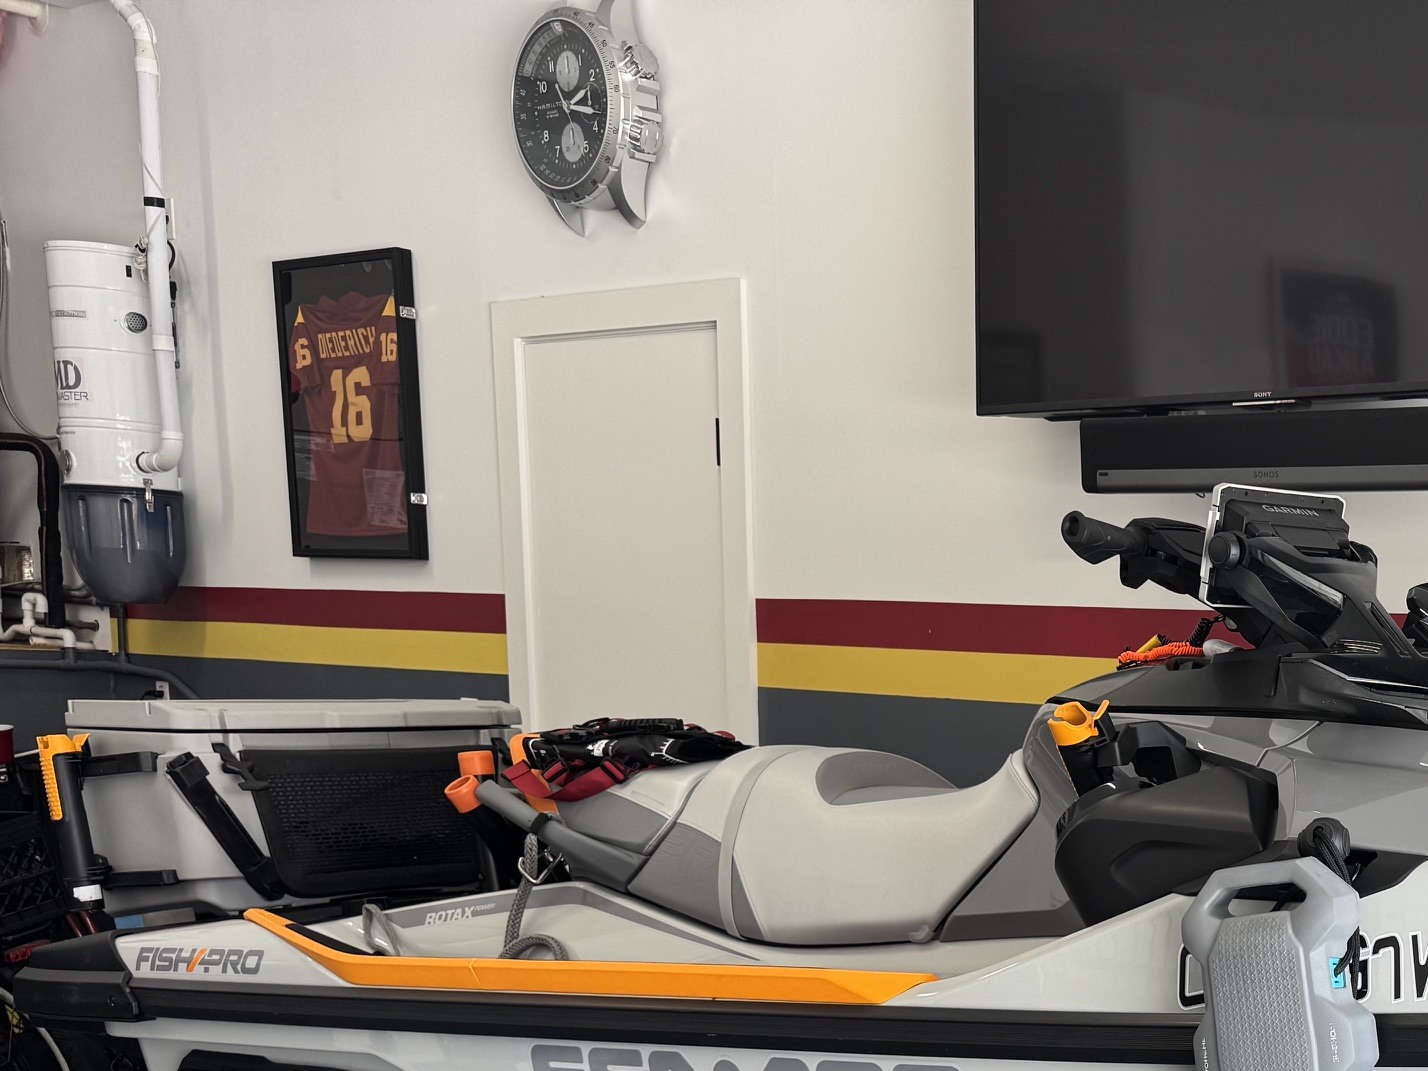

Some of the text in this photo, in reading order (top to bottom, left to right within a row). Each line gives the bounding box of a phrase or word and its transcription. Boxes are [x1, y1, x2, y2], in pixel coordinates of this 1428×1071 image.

[589, 69, 595, 82] 2
[538, 81, 547, 94] 10
[592, 119, 598, 132] 4
[543, 130, 549, 142] 8
[555, 146, 560, 158] 7
[380, 331, 398, 362] 16
[330, 365, 374, 444] 16
[1253, 471, 1279, 479] SONOS
[1261, 504, 1320, 517] GARMIN
[425, 906, 474, 926] ROTAX
